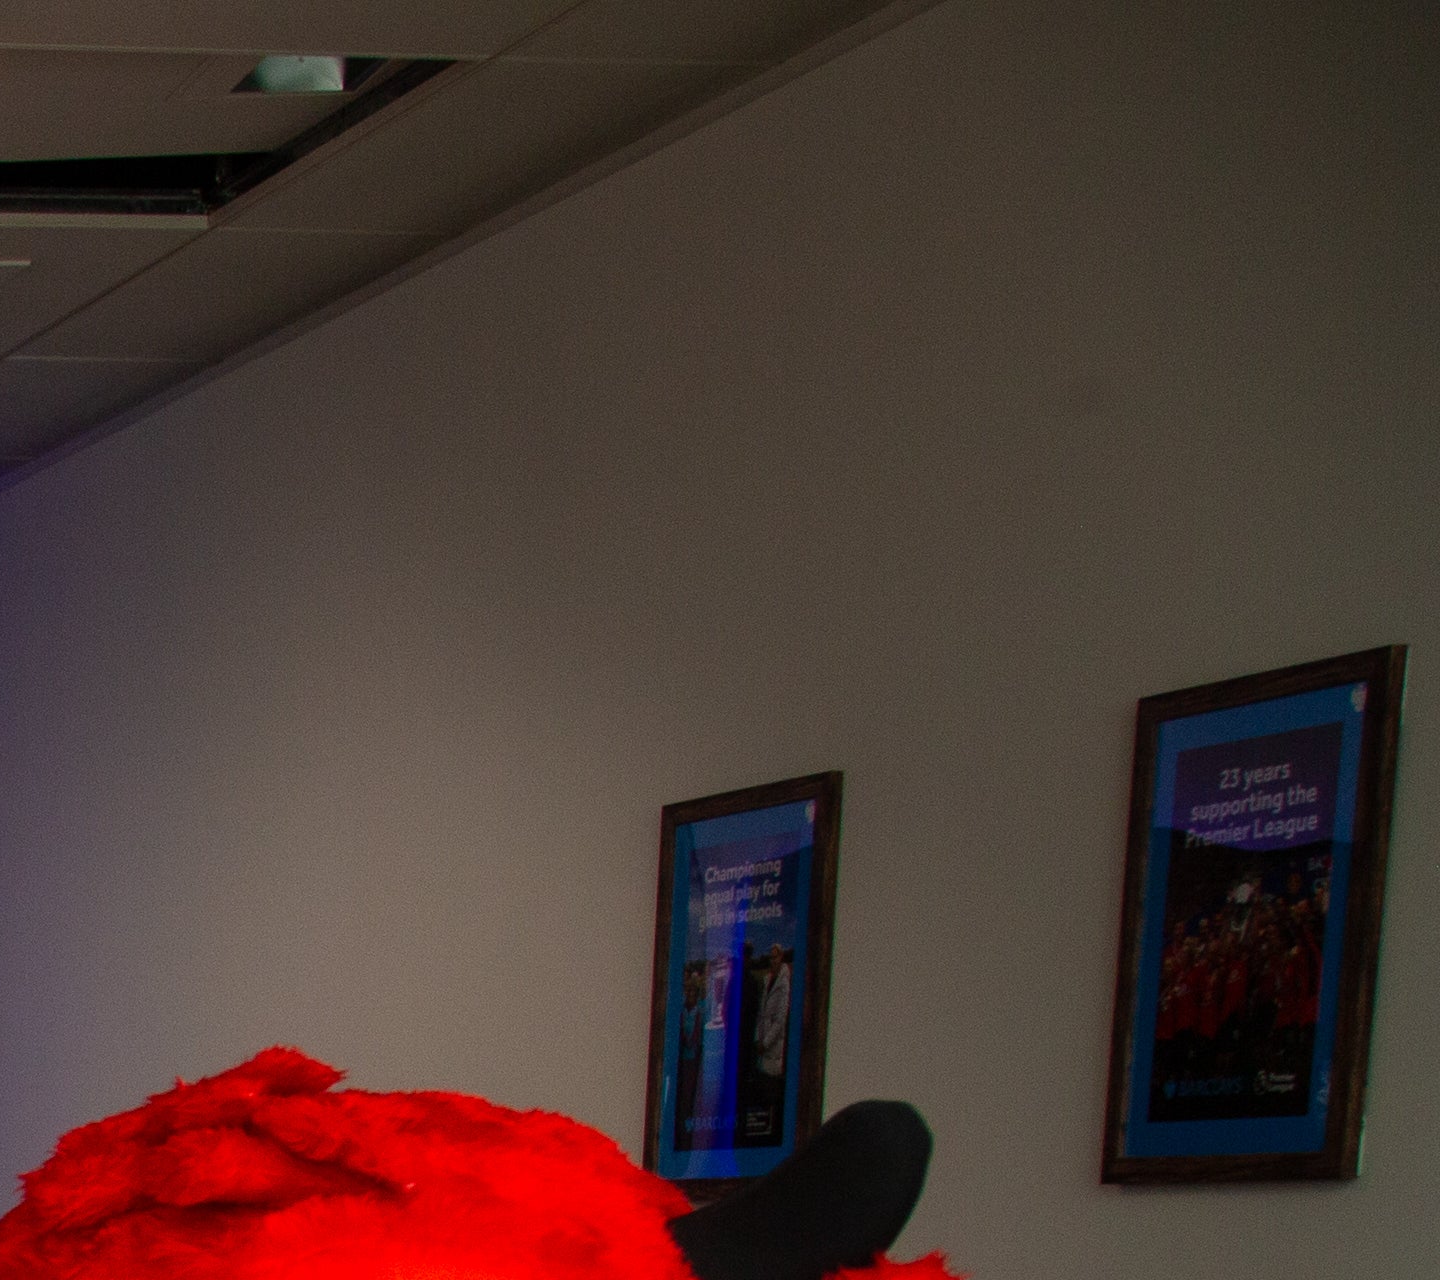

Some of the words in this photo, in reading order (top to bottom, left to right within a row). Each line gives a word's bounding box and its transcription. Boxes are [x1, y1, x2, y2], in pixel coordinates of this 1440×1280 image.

[1219, 768, 1242, 790] 23
[1243, 761, 1292, 792] years
[1190, 788, 1284, 823] supporting
[1286, 783, 1319, 806] the
[1184, 826, 1249, 850] Premier
[1252, 814, 1320, 843] League
[704, 857, 783, 884] Championing
[704, 888, 735, 912] equal
[736, 881, 761, 906] play
[762, 879, 781, 897] for
[737, 900, 783, 924] schools
